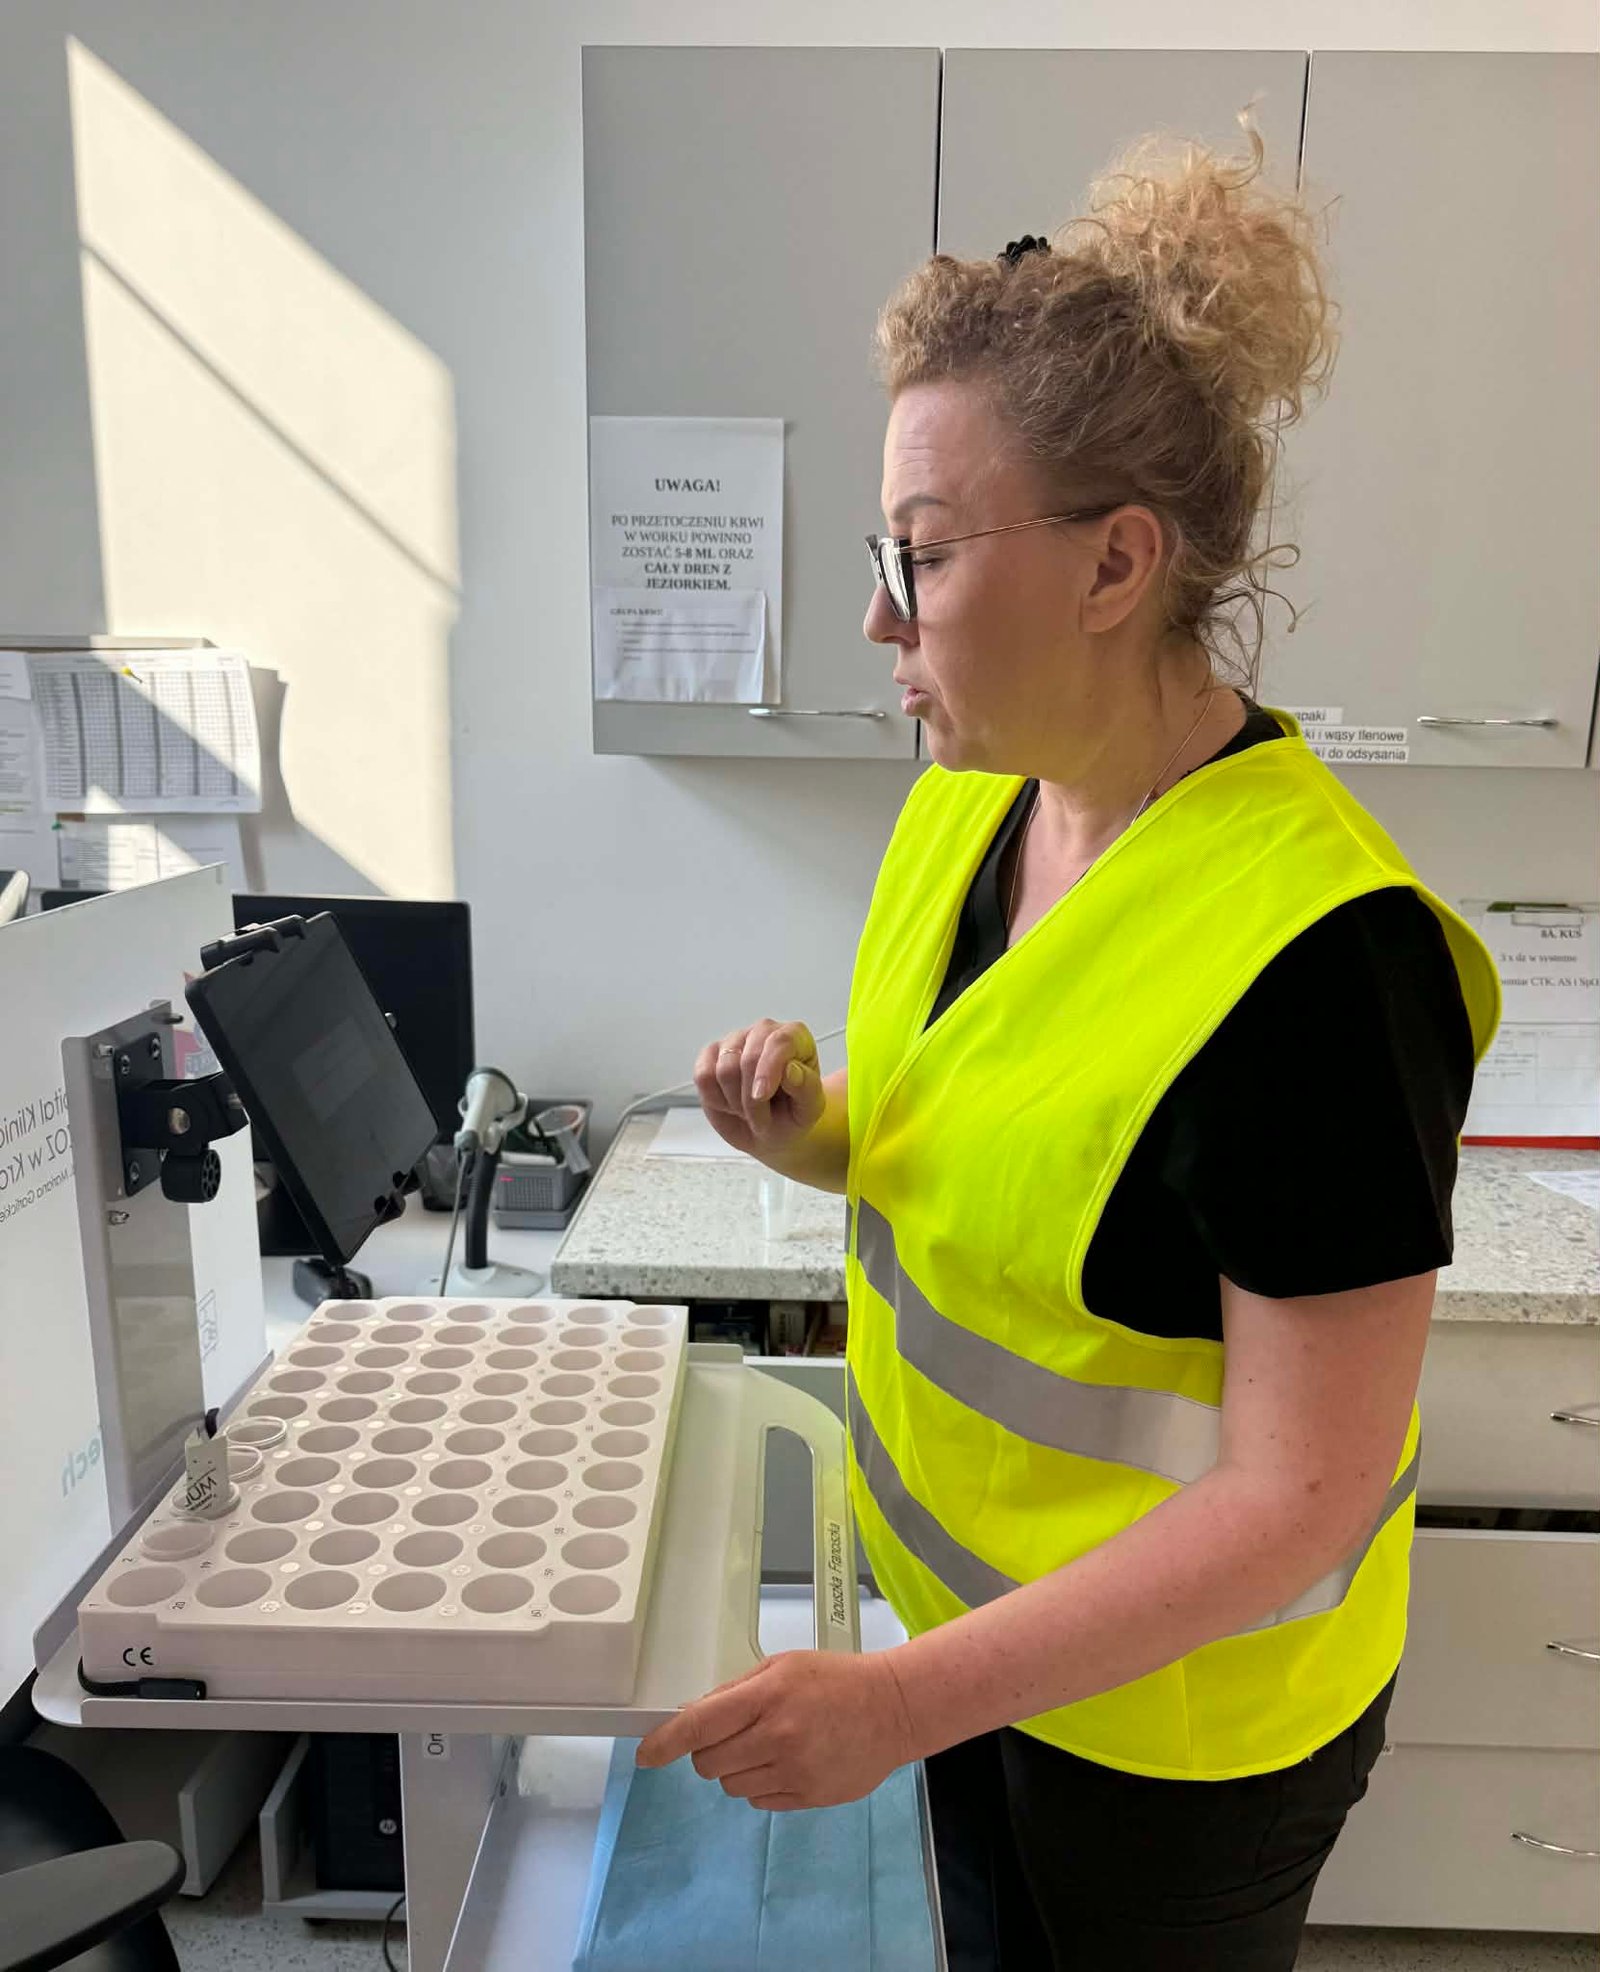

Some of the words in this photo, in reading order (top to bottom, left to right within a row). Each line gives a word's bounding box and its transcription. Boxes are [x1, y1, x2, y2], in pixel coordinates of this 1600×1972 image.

[655, 478, 721, 492] UWAGA!
[611, 515, 628, 526] PO
[631, 515, 727, 528] PRZETOCZENIU
[729, 516, 765, 529] KRWI
[624, 531, 637, 541] W
[640, 531, 688, 543] WORKU
[691, 532, 752, 544] POWINNO
[622, 546, 672, 558] ZOSTAĆ
[675, 547, 692, 558] 5-8
[719, 549, 754, 559] ORAZ
[644, 563, 681, 574] CAŁY
[684, 564, 720, 575] DREN
[723, 564, 732, 575] Z
[646, 578, 731, 590] JEZIORKIEM.
[1328, 747, 1343, 759] do
[1346, 748, 1406, 761] odsysania
[122, 1646, 155, 1667] CE
